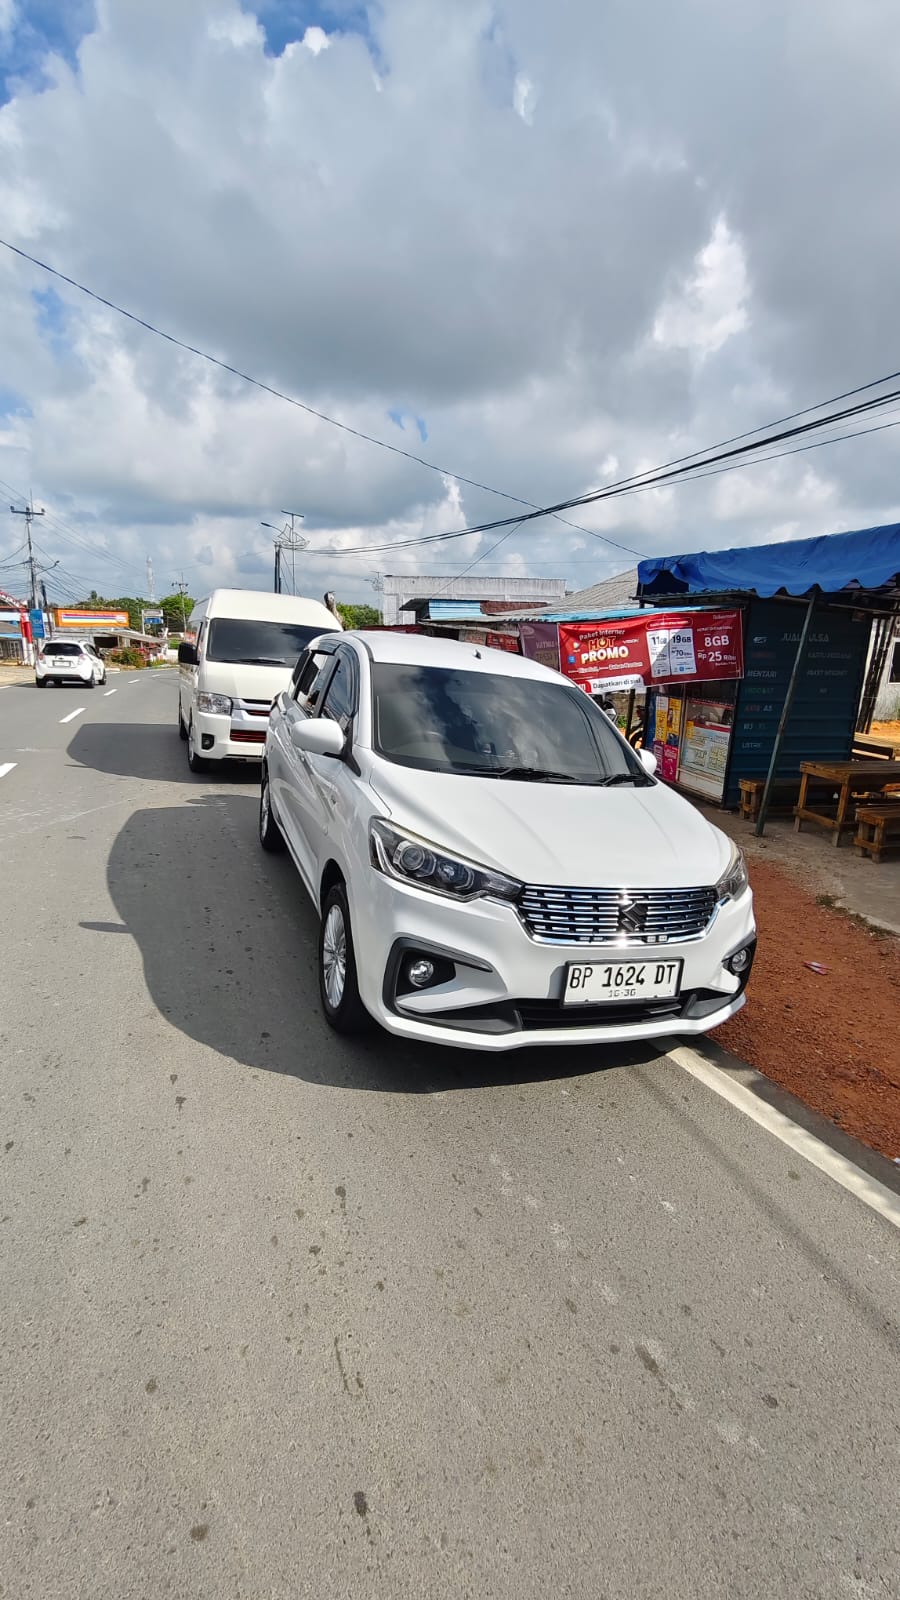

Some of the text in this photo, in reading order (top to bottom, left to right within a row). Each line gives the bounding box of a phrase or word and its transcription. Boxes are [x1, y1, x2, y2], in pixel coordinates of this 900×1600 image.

[588, 635, 617, 651] HOT
[704, 634, 730, 648] 8GB
[581, 645, 629, 665] PROMO
[697, 652, 707, 660] Rp
[708, 650, 723, 662] 25
[569, 964, 676, 989] BP 1624 DT
